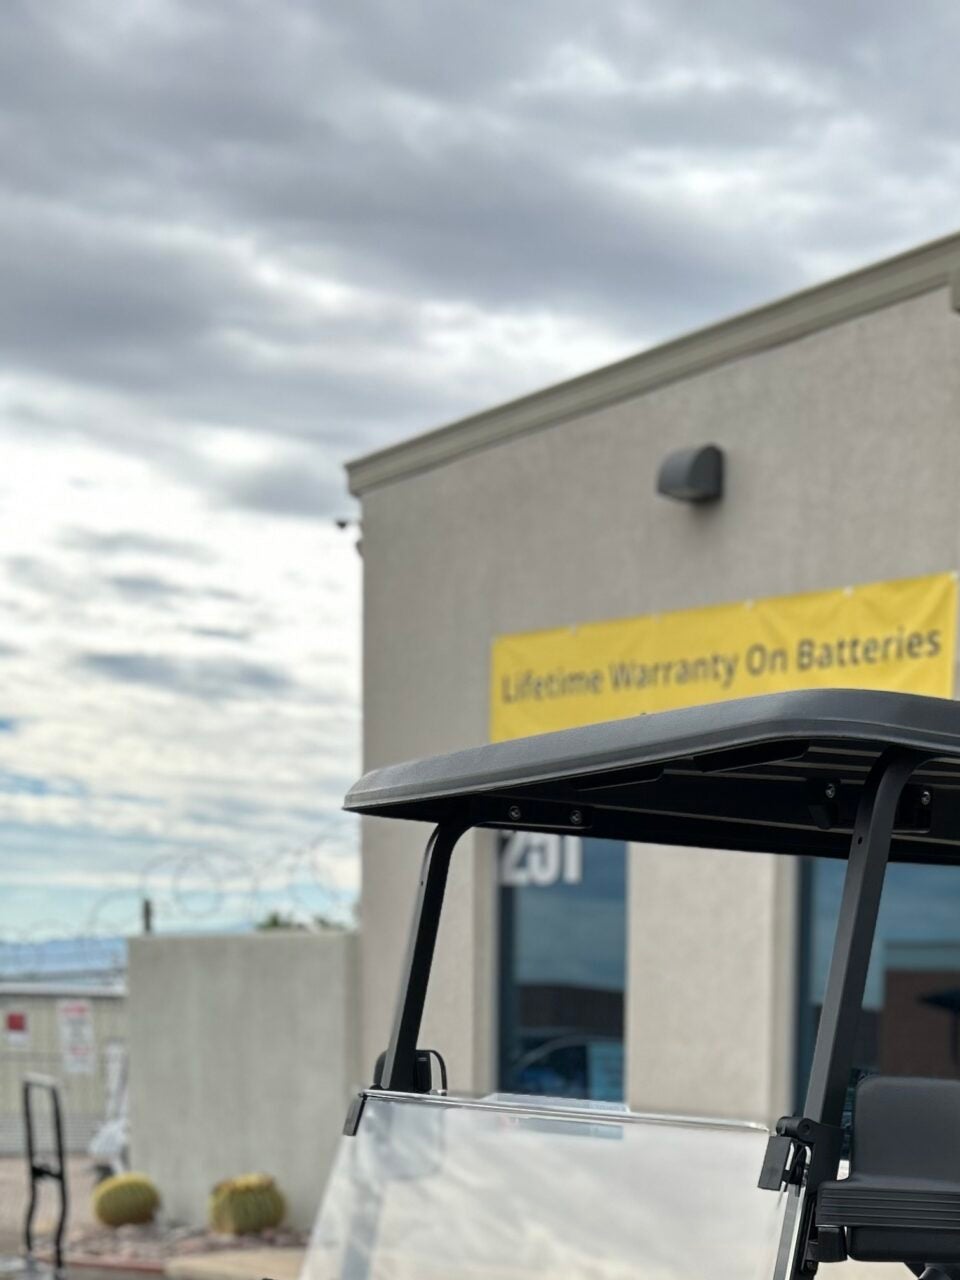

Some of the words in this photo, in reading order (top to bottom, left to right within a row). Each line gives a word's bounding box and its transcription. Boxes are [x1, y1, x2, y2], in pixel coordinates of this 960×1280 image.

[502, 669, 602, 702] Lifetime
[608, 652, 739, 693] Warranty
[745, 643, 788, 676] On
[797, 625, 941, 671] Batteries
